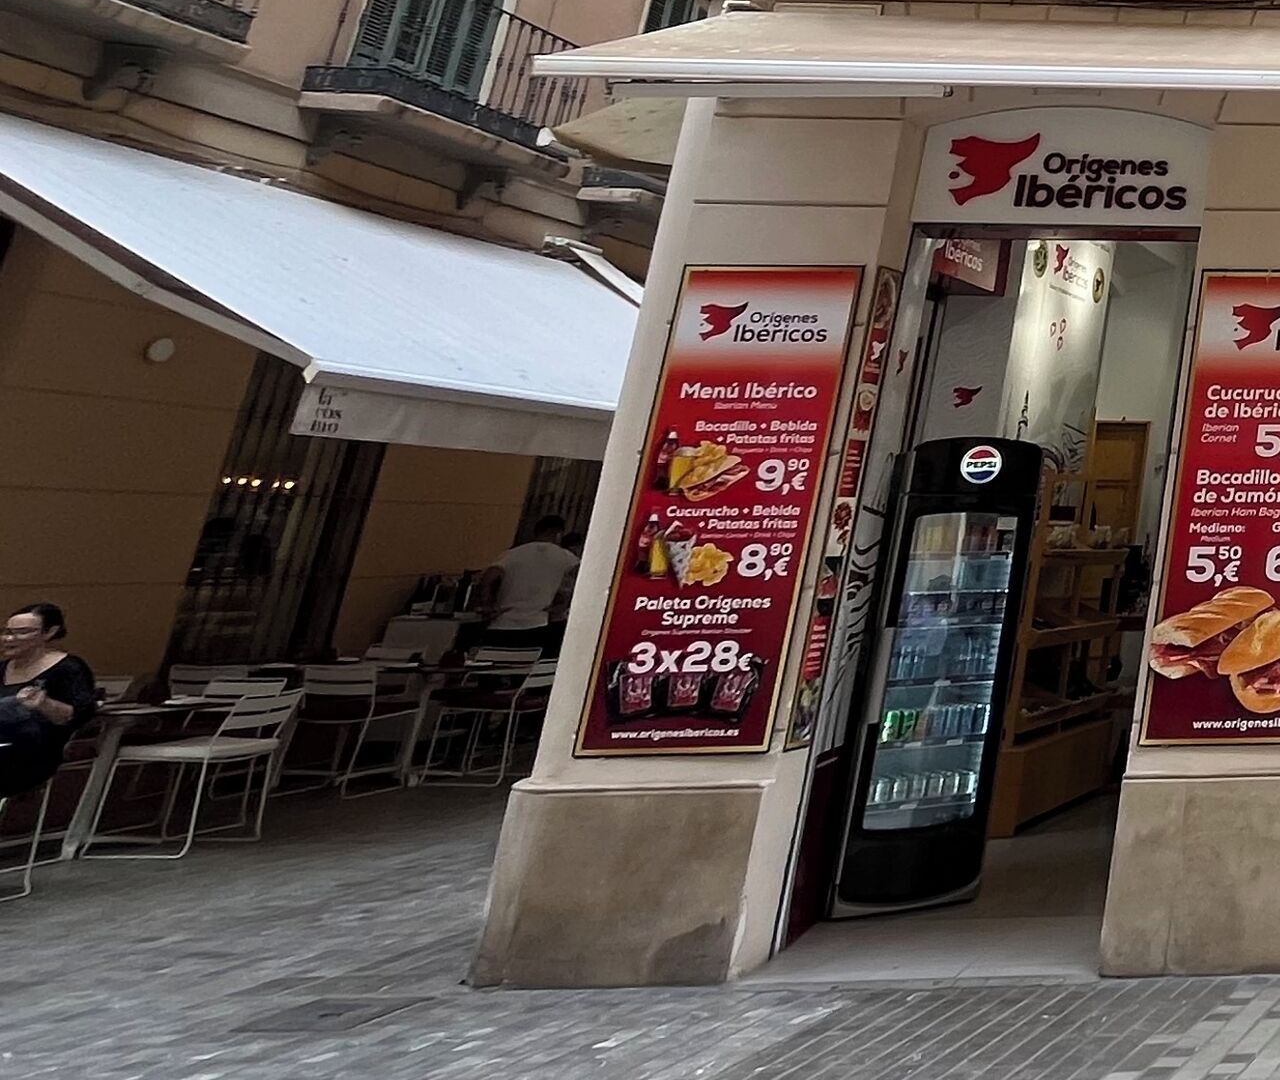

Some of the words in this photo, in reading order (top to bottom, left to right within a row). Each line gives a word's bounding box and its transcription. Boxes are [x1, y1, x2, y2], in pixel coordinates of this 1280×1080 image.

[1043, 153, 1169, 182] Orígenes
[1013, 174, 1187, 210] Ibéricos
[750, 311, 818, 327] Orígenes
[733, 324, 827, 342] Ibéricos
[680, 382, 739, 399] Menú
[744, 382, 817, 399] Ibérico
[1204, 403, 1229, 418] de
[695, 420, 757, 431] Bocadillo
[770, 420, 817, 431] Bebida
[1202, 423, 1239, 433] Iberian
[726, 434, 777, 444] Patatas
[1201, 433, 1237, 443] Cornet
[966, 461, 997, 469] PEPSI
[1196, 470, 1280, 485] Bocadillo
[1193, 488, 1217, 503] de
[666, 506, 739, 517] Cucurucho
[752, 505, 800, 516] Bebida
[1190, 508, 1229, 517] Iberian
[1231, 508, 1257, 517] Ham
[707, 519, 760, 529] Patatas
[762, 518, 798, 529] fritas
[1189, 522, 1246, 534] Mediano:
[634, 596, 691, 611] Paleta
[694, 595, 772, 613] Orígenes
[661, 611, 739, 628] Supreme
[627, 640, 753, 674] 3x28€
